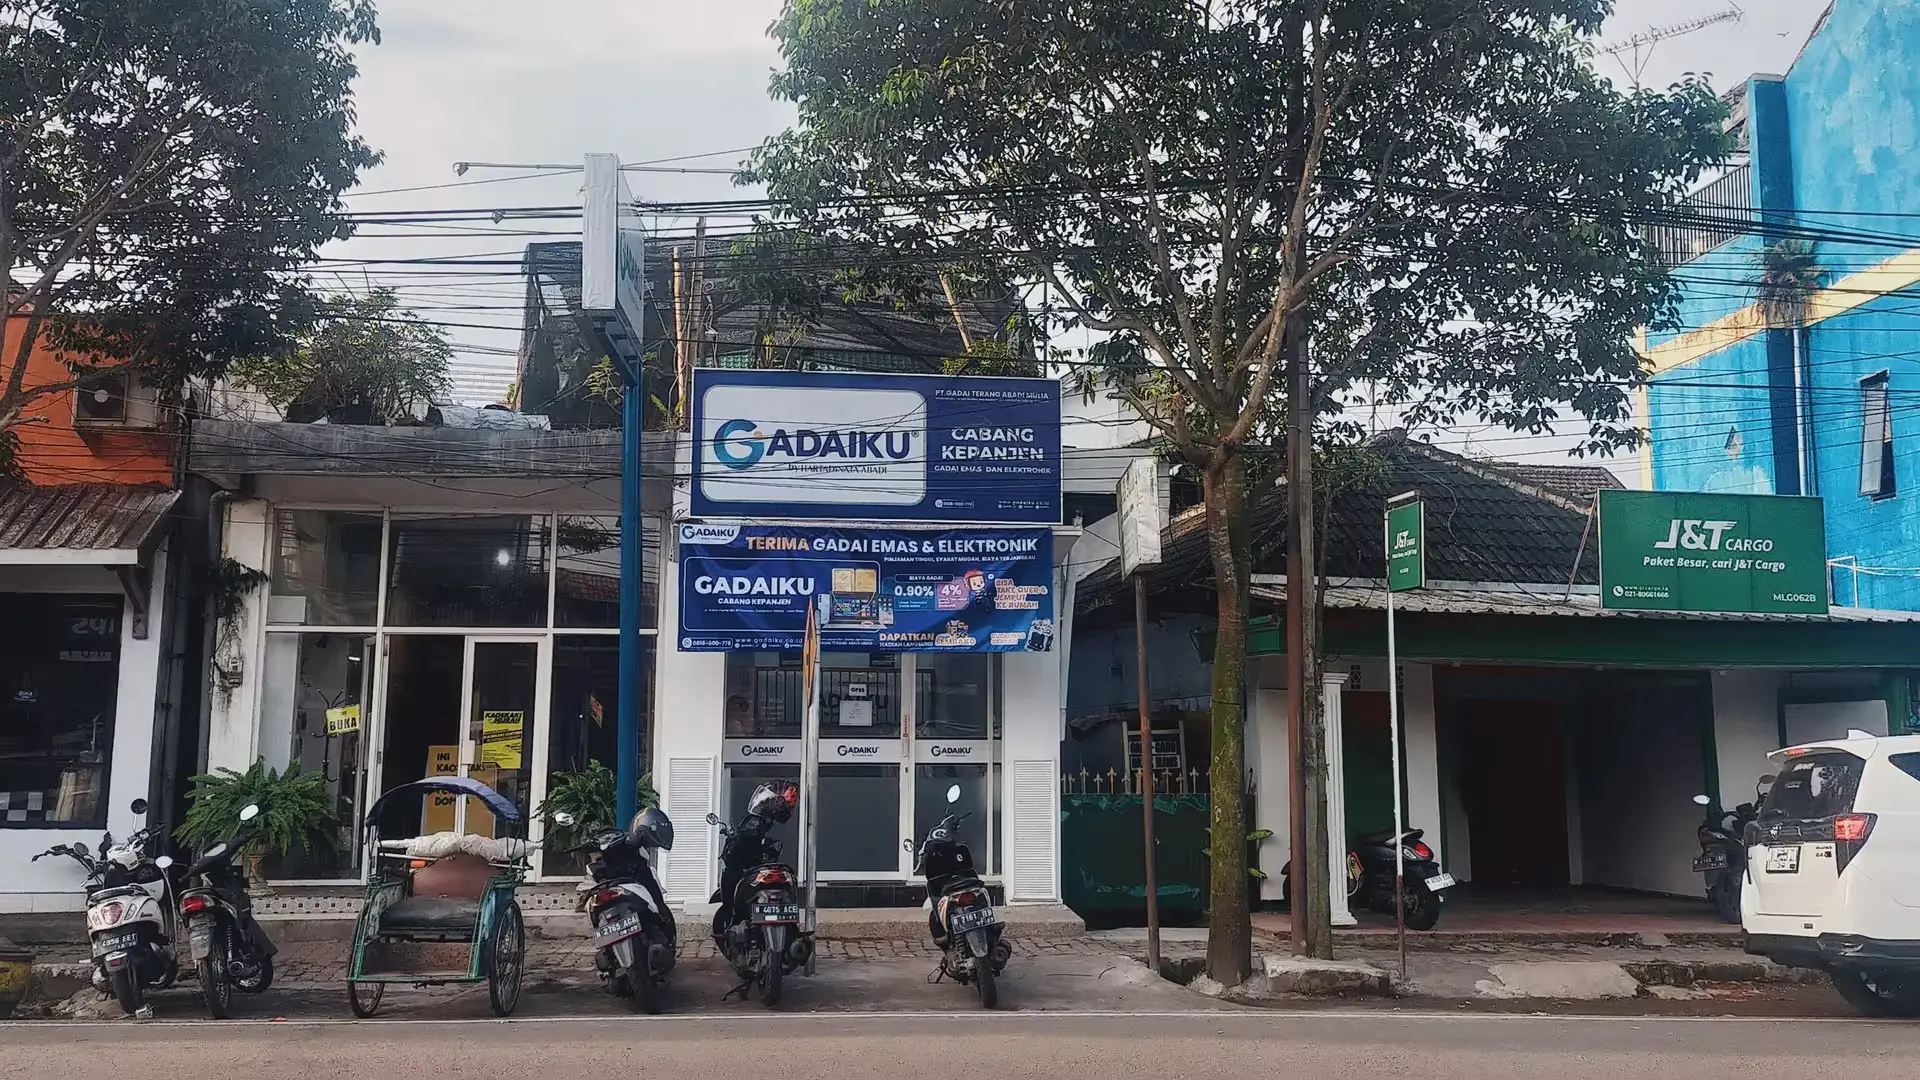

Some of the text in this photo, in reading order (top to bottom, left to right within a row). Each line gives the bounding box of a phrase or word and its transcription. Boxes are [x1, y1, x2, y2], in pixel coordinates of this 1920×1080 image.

[971, 390, 1000, 398] TERANG
[951, 427, 1034, 442] CABANG
[942, 445, 1044, 461] KEPANJEN
[682, 525, 735, 539] GADAIKU
[1654, 519, 1773, 552] J&T CARGO
[746, 536, 1038, 553] TERIMA GADAI EMAS & ELEKTRONIK
[1643, 556, 1786, 573] Paket Besar, cari J&T Cargo
[694, 575, 815, 595] GADAIKU
[894, 585, 934, 596] 0.90%
[941, 585, 962, 596] 4%
[1773, 593, 1816, 602] MLG062B
[879, 633, 935, 641] DAPATKAN
[936, 638, 976, 646] SEMBAKO
[330, 717, 357, 731] BUKA
[741, 745, 785, 756] GADAIKU
[837, 745, 879, 756] GADAIKU
[931, 745, 973, 757] GADAIKU
[437, 753, 450, 761] INI
[122, 933, 136, 942] EET
